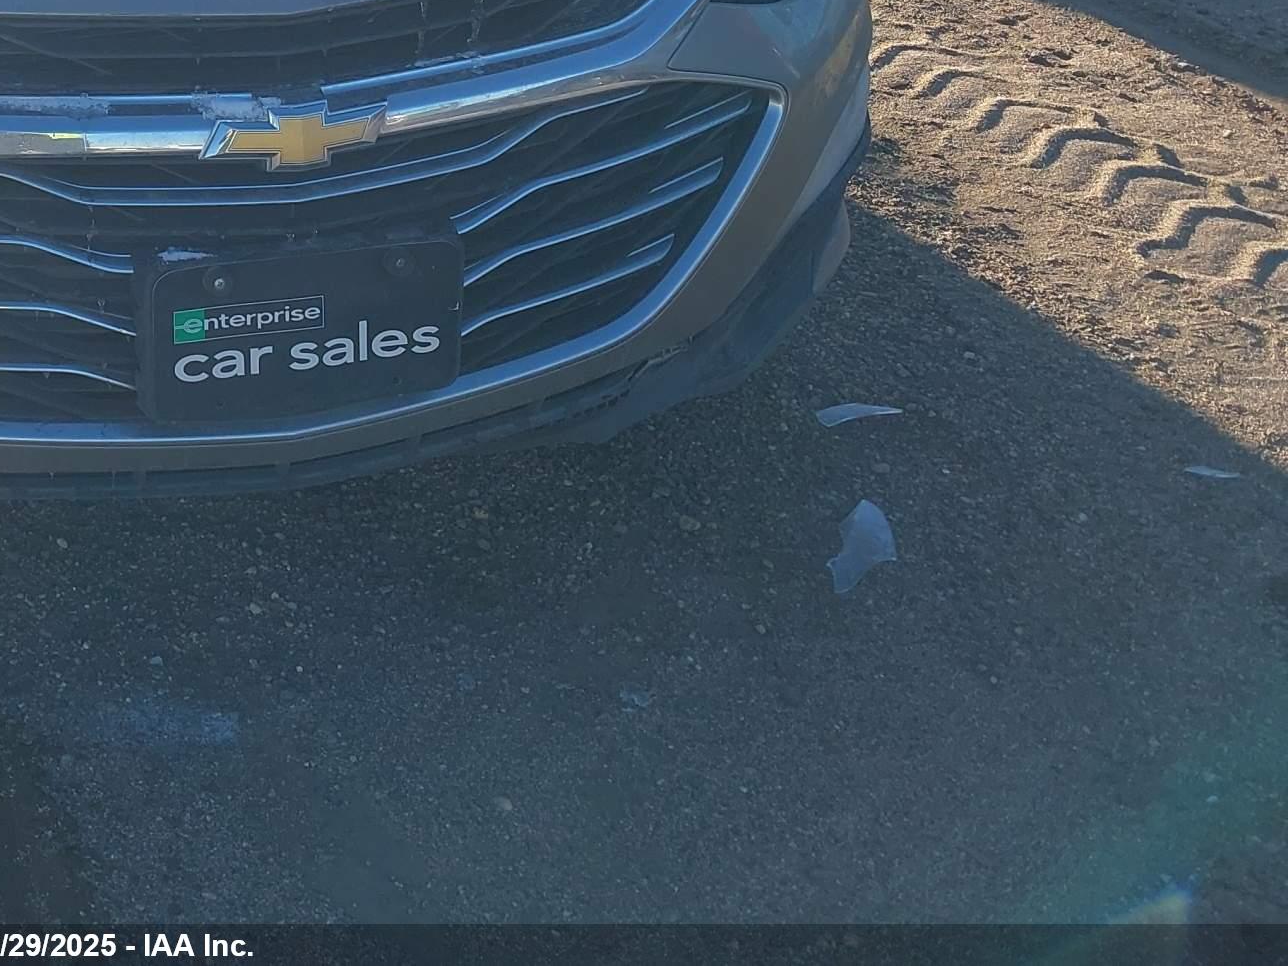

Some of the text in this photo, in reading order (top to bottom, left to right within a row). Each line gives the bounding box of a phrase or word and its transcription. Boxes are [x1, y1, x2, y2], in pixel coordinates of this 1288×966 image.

[183, 305, 321, 334] enterprise
[174, 320, 440, 382] car sales
